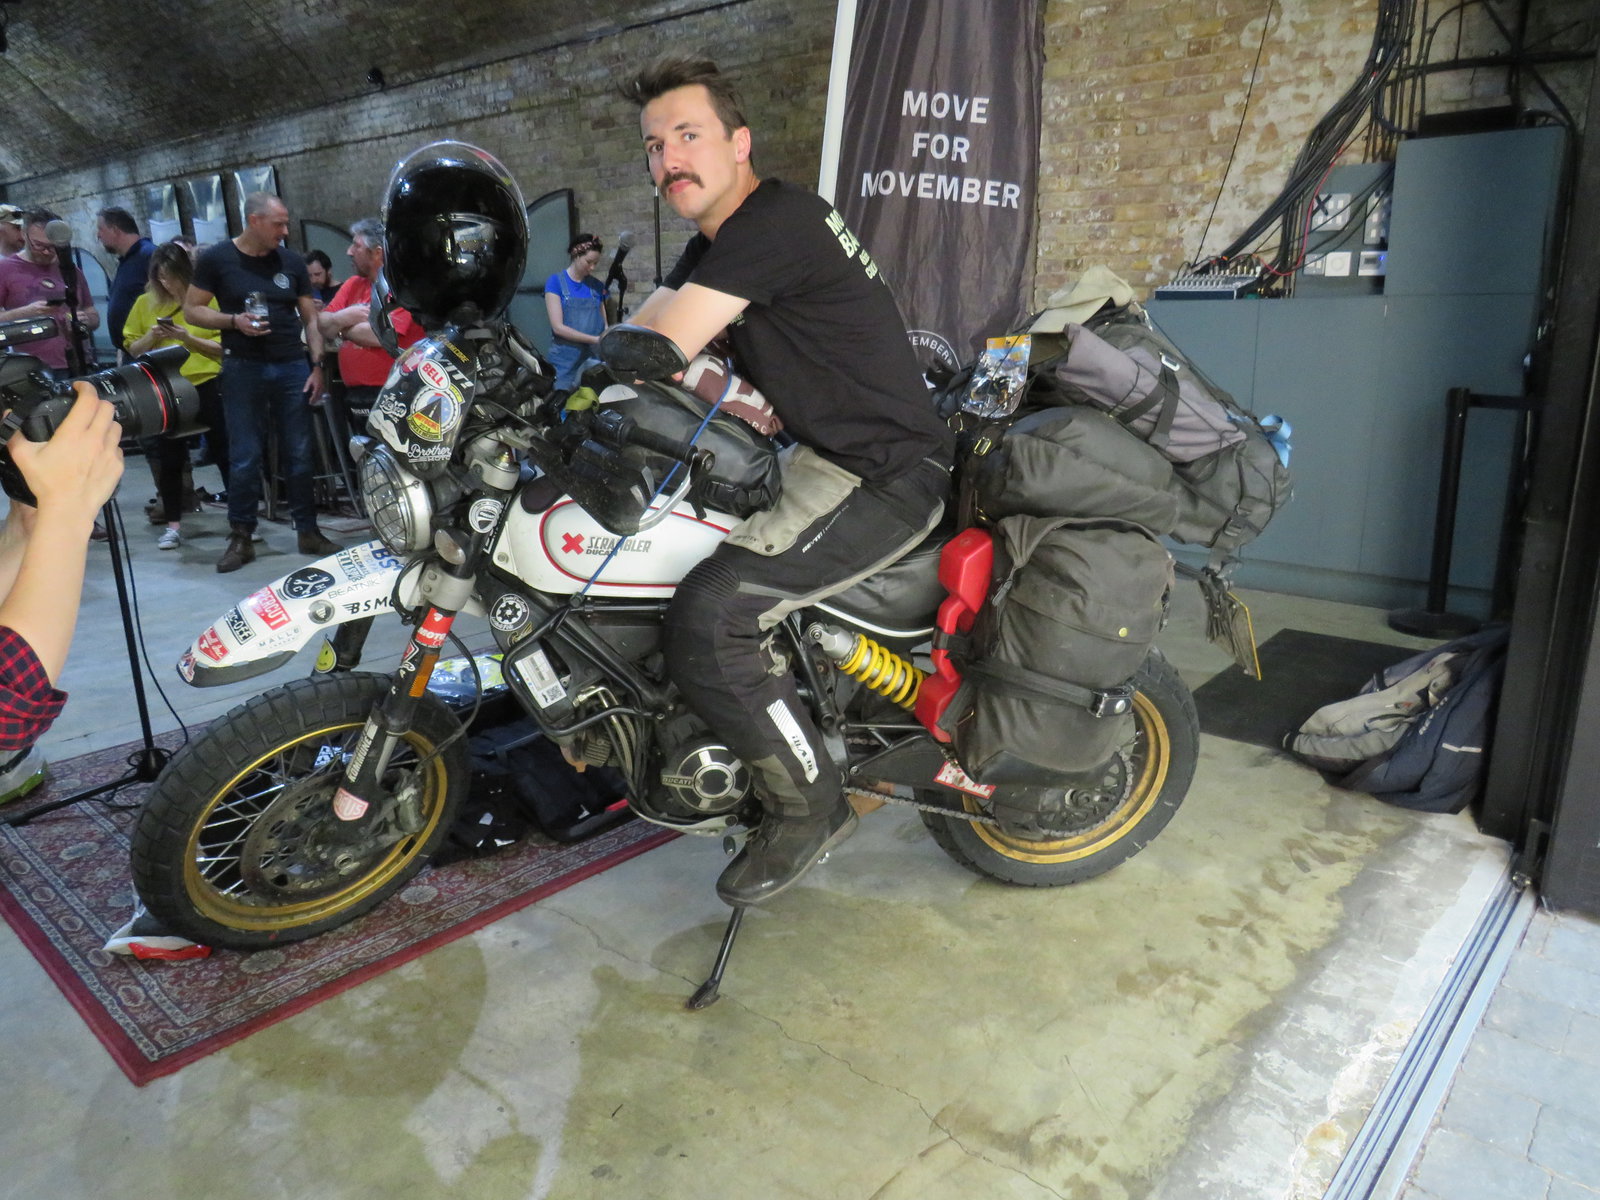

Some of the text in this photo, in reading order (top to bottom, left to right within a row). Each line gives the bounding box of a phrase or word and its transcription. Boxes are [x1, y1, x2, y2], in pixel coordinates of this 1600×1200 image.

[902, 90, 990, 124] MOVE
[911, 132, 970, 163] FOR
[861, 170, 1021, 209] MOVEMBER
[909, 336, 950, 361] EMBER
[422, 363, 444, 387] BELL
[407, 443, 452, 459] Brother
[253, 588, 289, 627] PPERCUT
[347, 735, 373, 783] KOMMUNE
[662, 777, 692, 787] DUCATI
